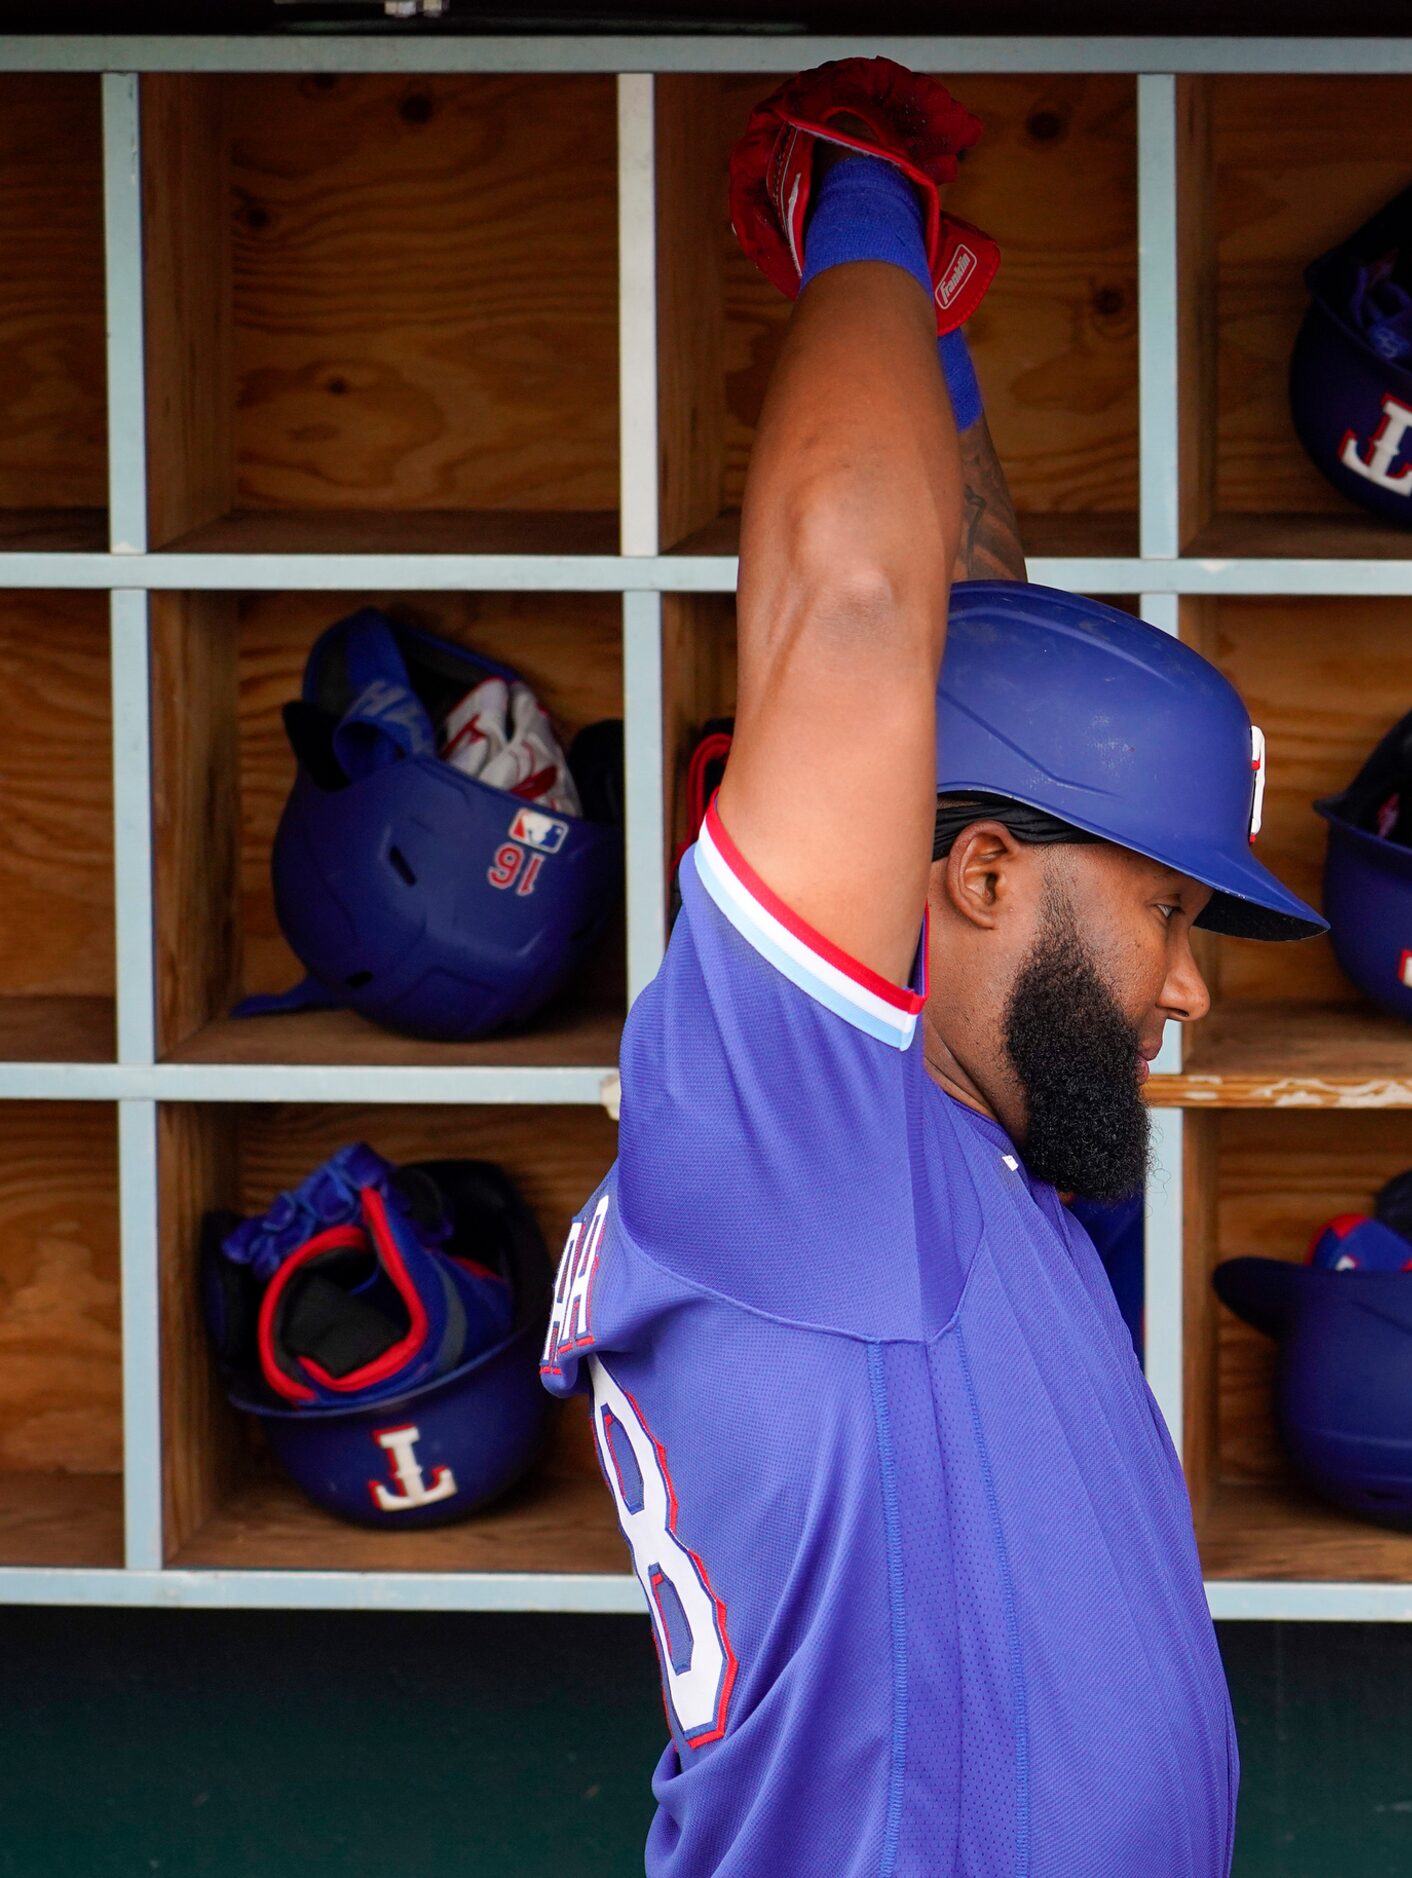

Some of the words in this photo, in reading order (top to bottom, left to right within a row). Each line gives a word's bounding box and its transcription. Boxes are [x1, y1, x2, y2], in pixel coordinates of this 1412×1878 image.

[939, 252, 971, 305] Franklin
[486, 842, 546, 897] 16
[367, 1422, 458, 1513] T
[590, 1352, 738, 1748] 8
